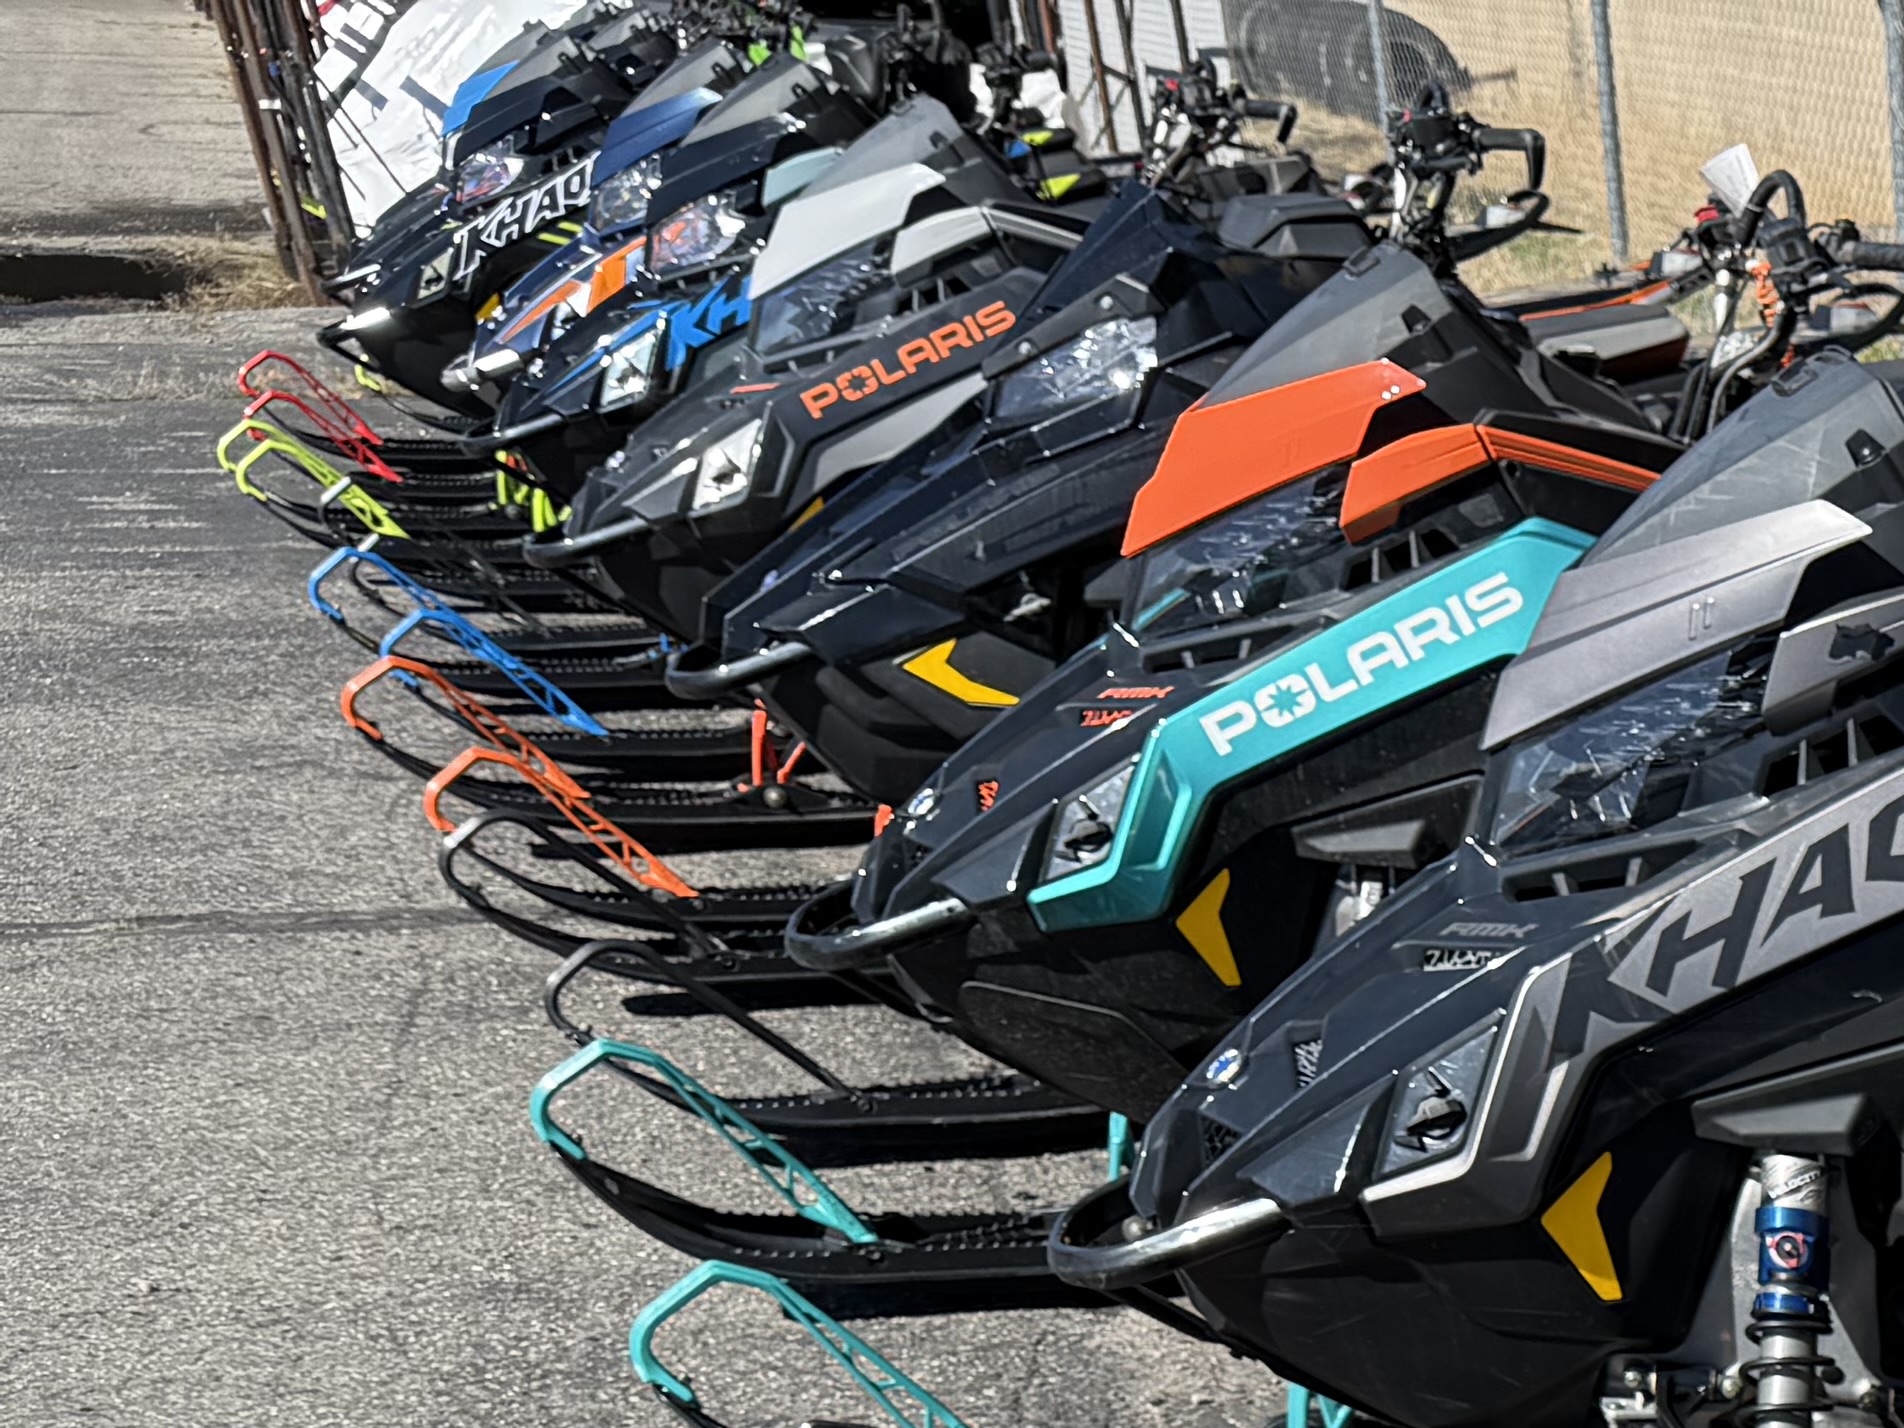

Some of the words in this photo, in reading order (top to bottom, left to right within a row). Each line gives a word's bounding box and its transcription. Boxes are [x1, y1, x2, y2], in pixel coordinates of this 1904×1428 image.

[452, 150, 602, 282] KHAO
[800, 301, 1017, 420] POLARIS
[1199, 572, 1524, 756] POLARIS
